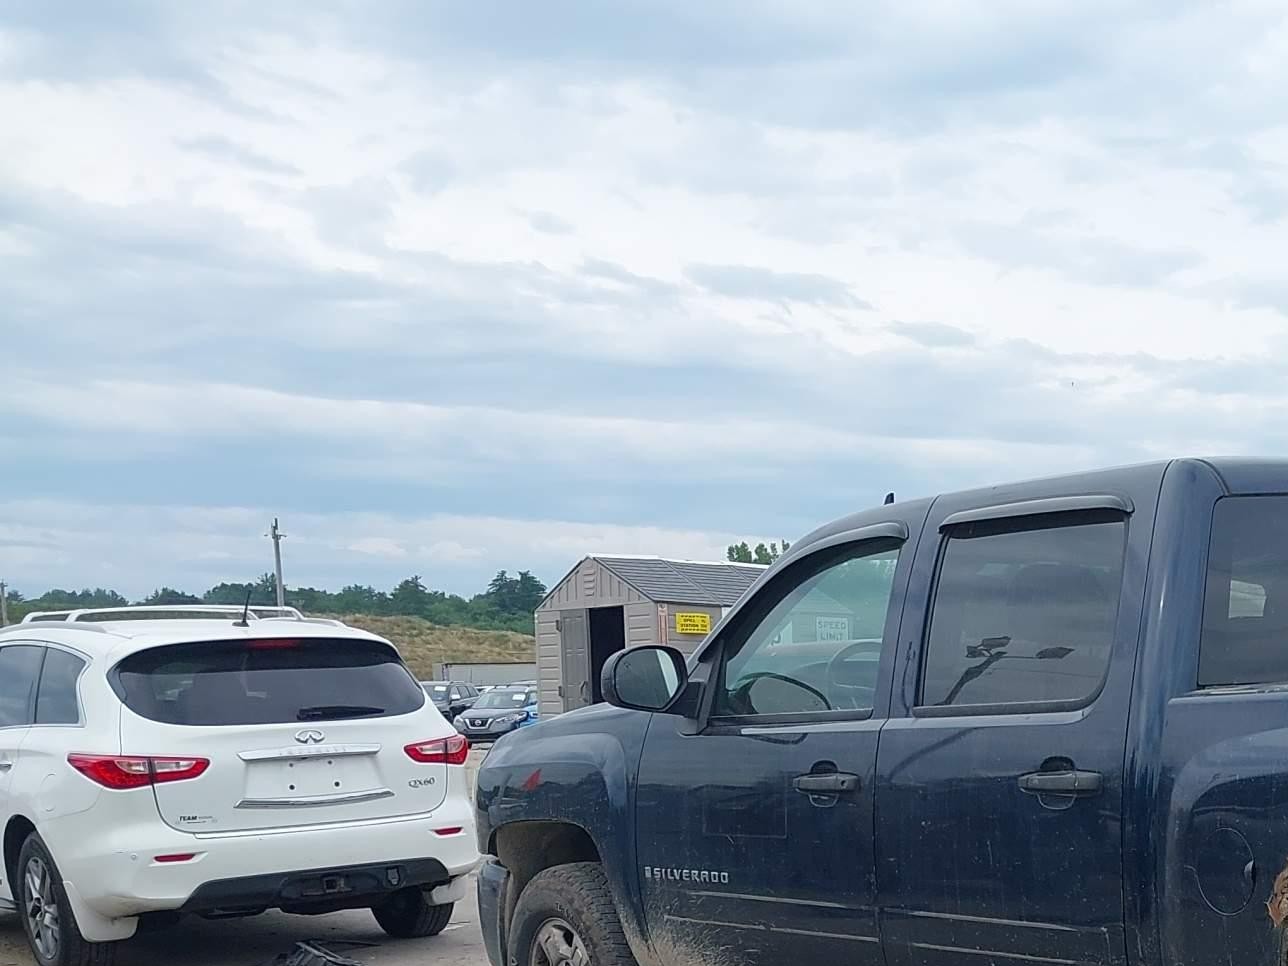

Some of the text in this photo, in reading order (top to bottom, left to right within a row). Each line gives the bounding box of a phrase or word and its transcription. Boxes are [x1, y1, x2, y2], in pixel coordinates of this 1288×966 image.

[817, 621, 846, 630] SPEED
[820, 630, 843, 640] LIMIT
[408, 777, 435, 788] QX60
[653, 867, 729, 883] SILVERADO
